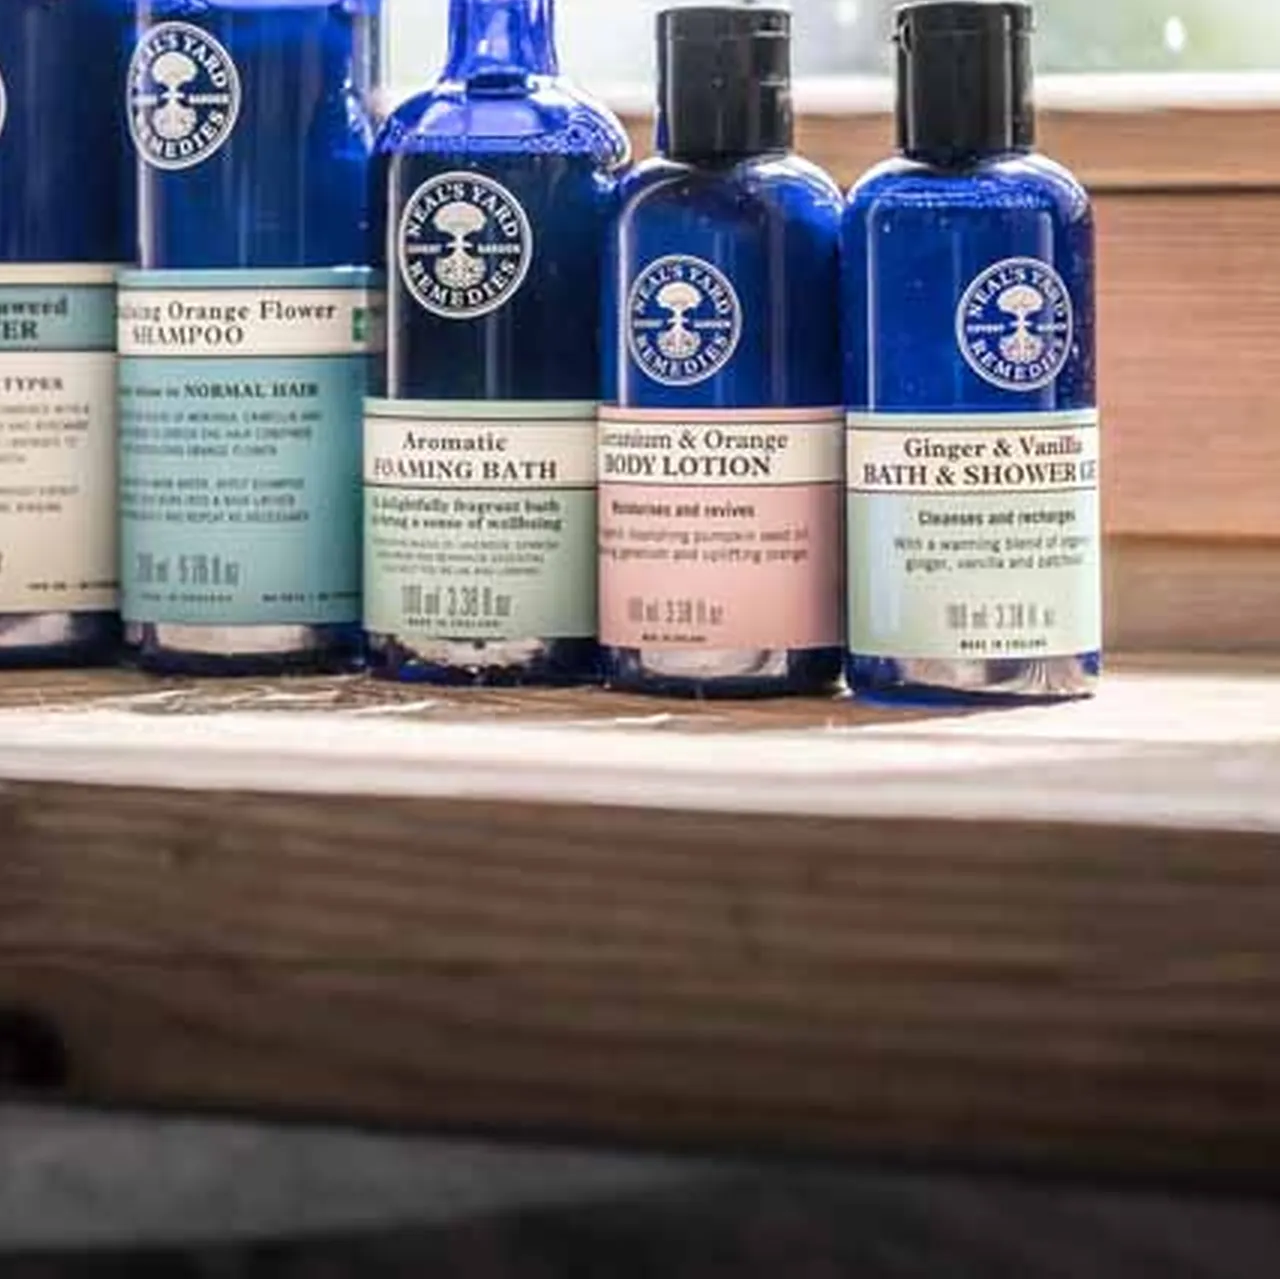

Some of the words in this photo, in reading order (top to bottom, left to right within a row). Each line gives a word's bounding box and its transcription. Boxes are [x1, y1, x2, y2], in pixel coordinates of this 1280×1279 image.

[182, 35, 228, 89] YARD
[406, 182, 465, 238] NEAL'S
[472, 184, 519, 238] YARD
[409, 258, 516, 308] REMEDIES
[689, 266, 732, 315] YARD
[168, 300, 251, 322] Orange
[260, 301, 338, 320] Flower
[132, 324, 244, 345] SHAMPOO
[635, 331, 729, 377] REMEDIES
[4, 375, 64, 392] TYPES
[184, 382, 266, 398] NORMAL
[272, 382, 319, 398] HAIR
[402, 430, 509, 452] Aromatic
[678, 430, 697, 450] &
[704, 429, 789, 452] Orange
[903, 437, 987, 461] Ginger
[993, 438, 1013, 458] &
[374, 458, 473, 480] FOAMING
[482, 460, 558, 480] BATH
[603, 454, 657, 475] BODY
[662, 454, 771, 476] LOTION
[862, 464, 927, 486] BATH
[935, 464, 956, 485] &
[963, 461, 1076, 485] SHOWER
[675, 502, 700, 517] and
[705, 499, 755, 517] revives
[918, 511, 984, 526] Cleanses
[988, 510, 1014, 525] and
[1004, 536, 1043, 551] blend
[1008, 555, 1034, 569] and
